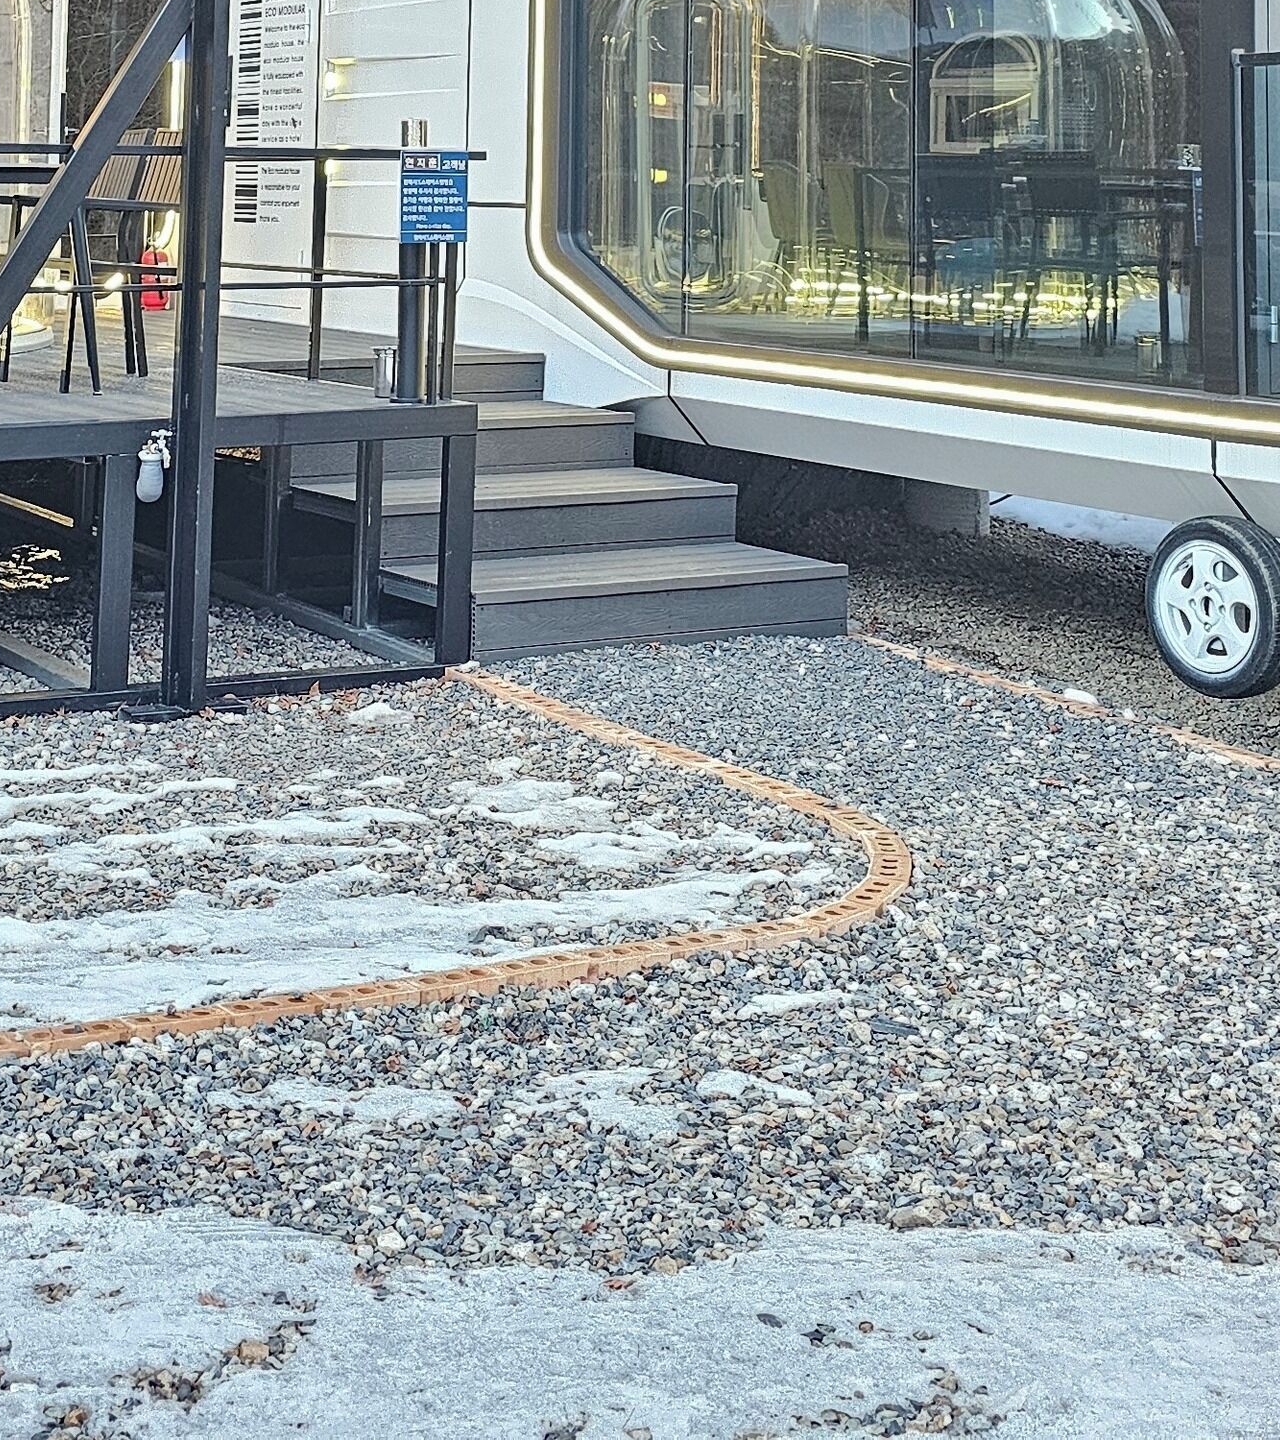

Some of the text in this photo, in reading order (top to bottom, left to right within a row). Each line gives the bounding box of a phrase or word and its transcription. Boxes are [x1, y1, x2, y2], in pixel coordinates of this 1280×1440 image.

[265, 4, 305, 18] ECO MODULAR
[441, 160, 466, 171] 고객님
